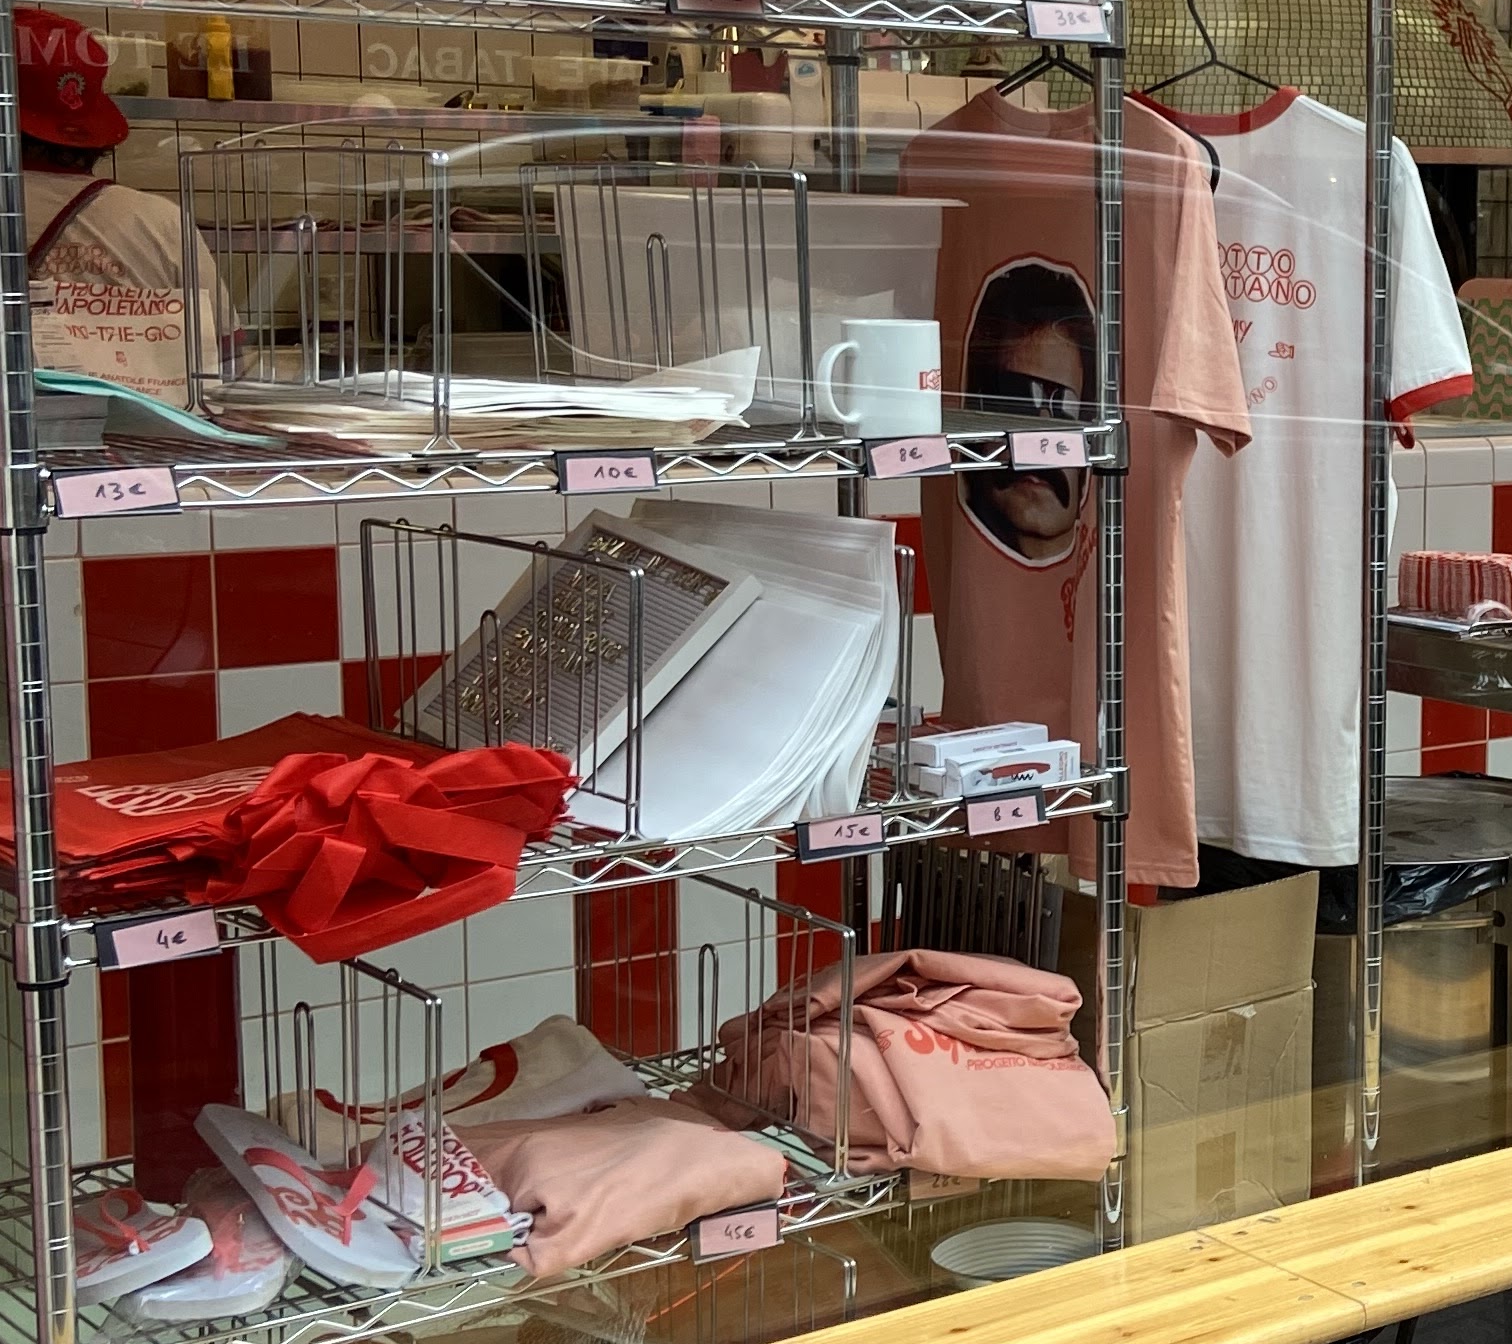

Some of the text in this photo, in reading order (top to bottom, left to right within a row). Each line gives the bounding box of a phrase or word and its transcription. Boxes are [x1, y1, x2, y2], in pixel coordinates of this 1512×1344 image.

[1054, 9, 1091, 27] 38€
[594, 465, 638, 479] 10€
[95, 482, 147, 501] 13€
[834, 824, 870, 838] 15€
[156, 929, 188, 949] 4€
[723, 1224, 756, 1241] 45€
